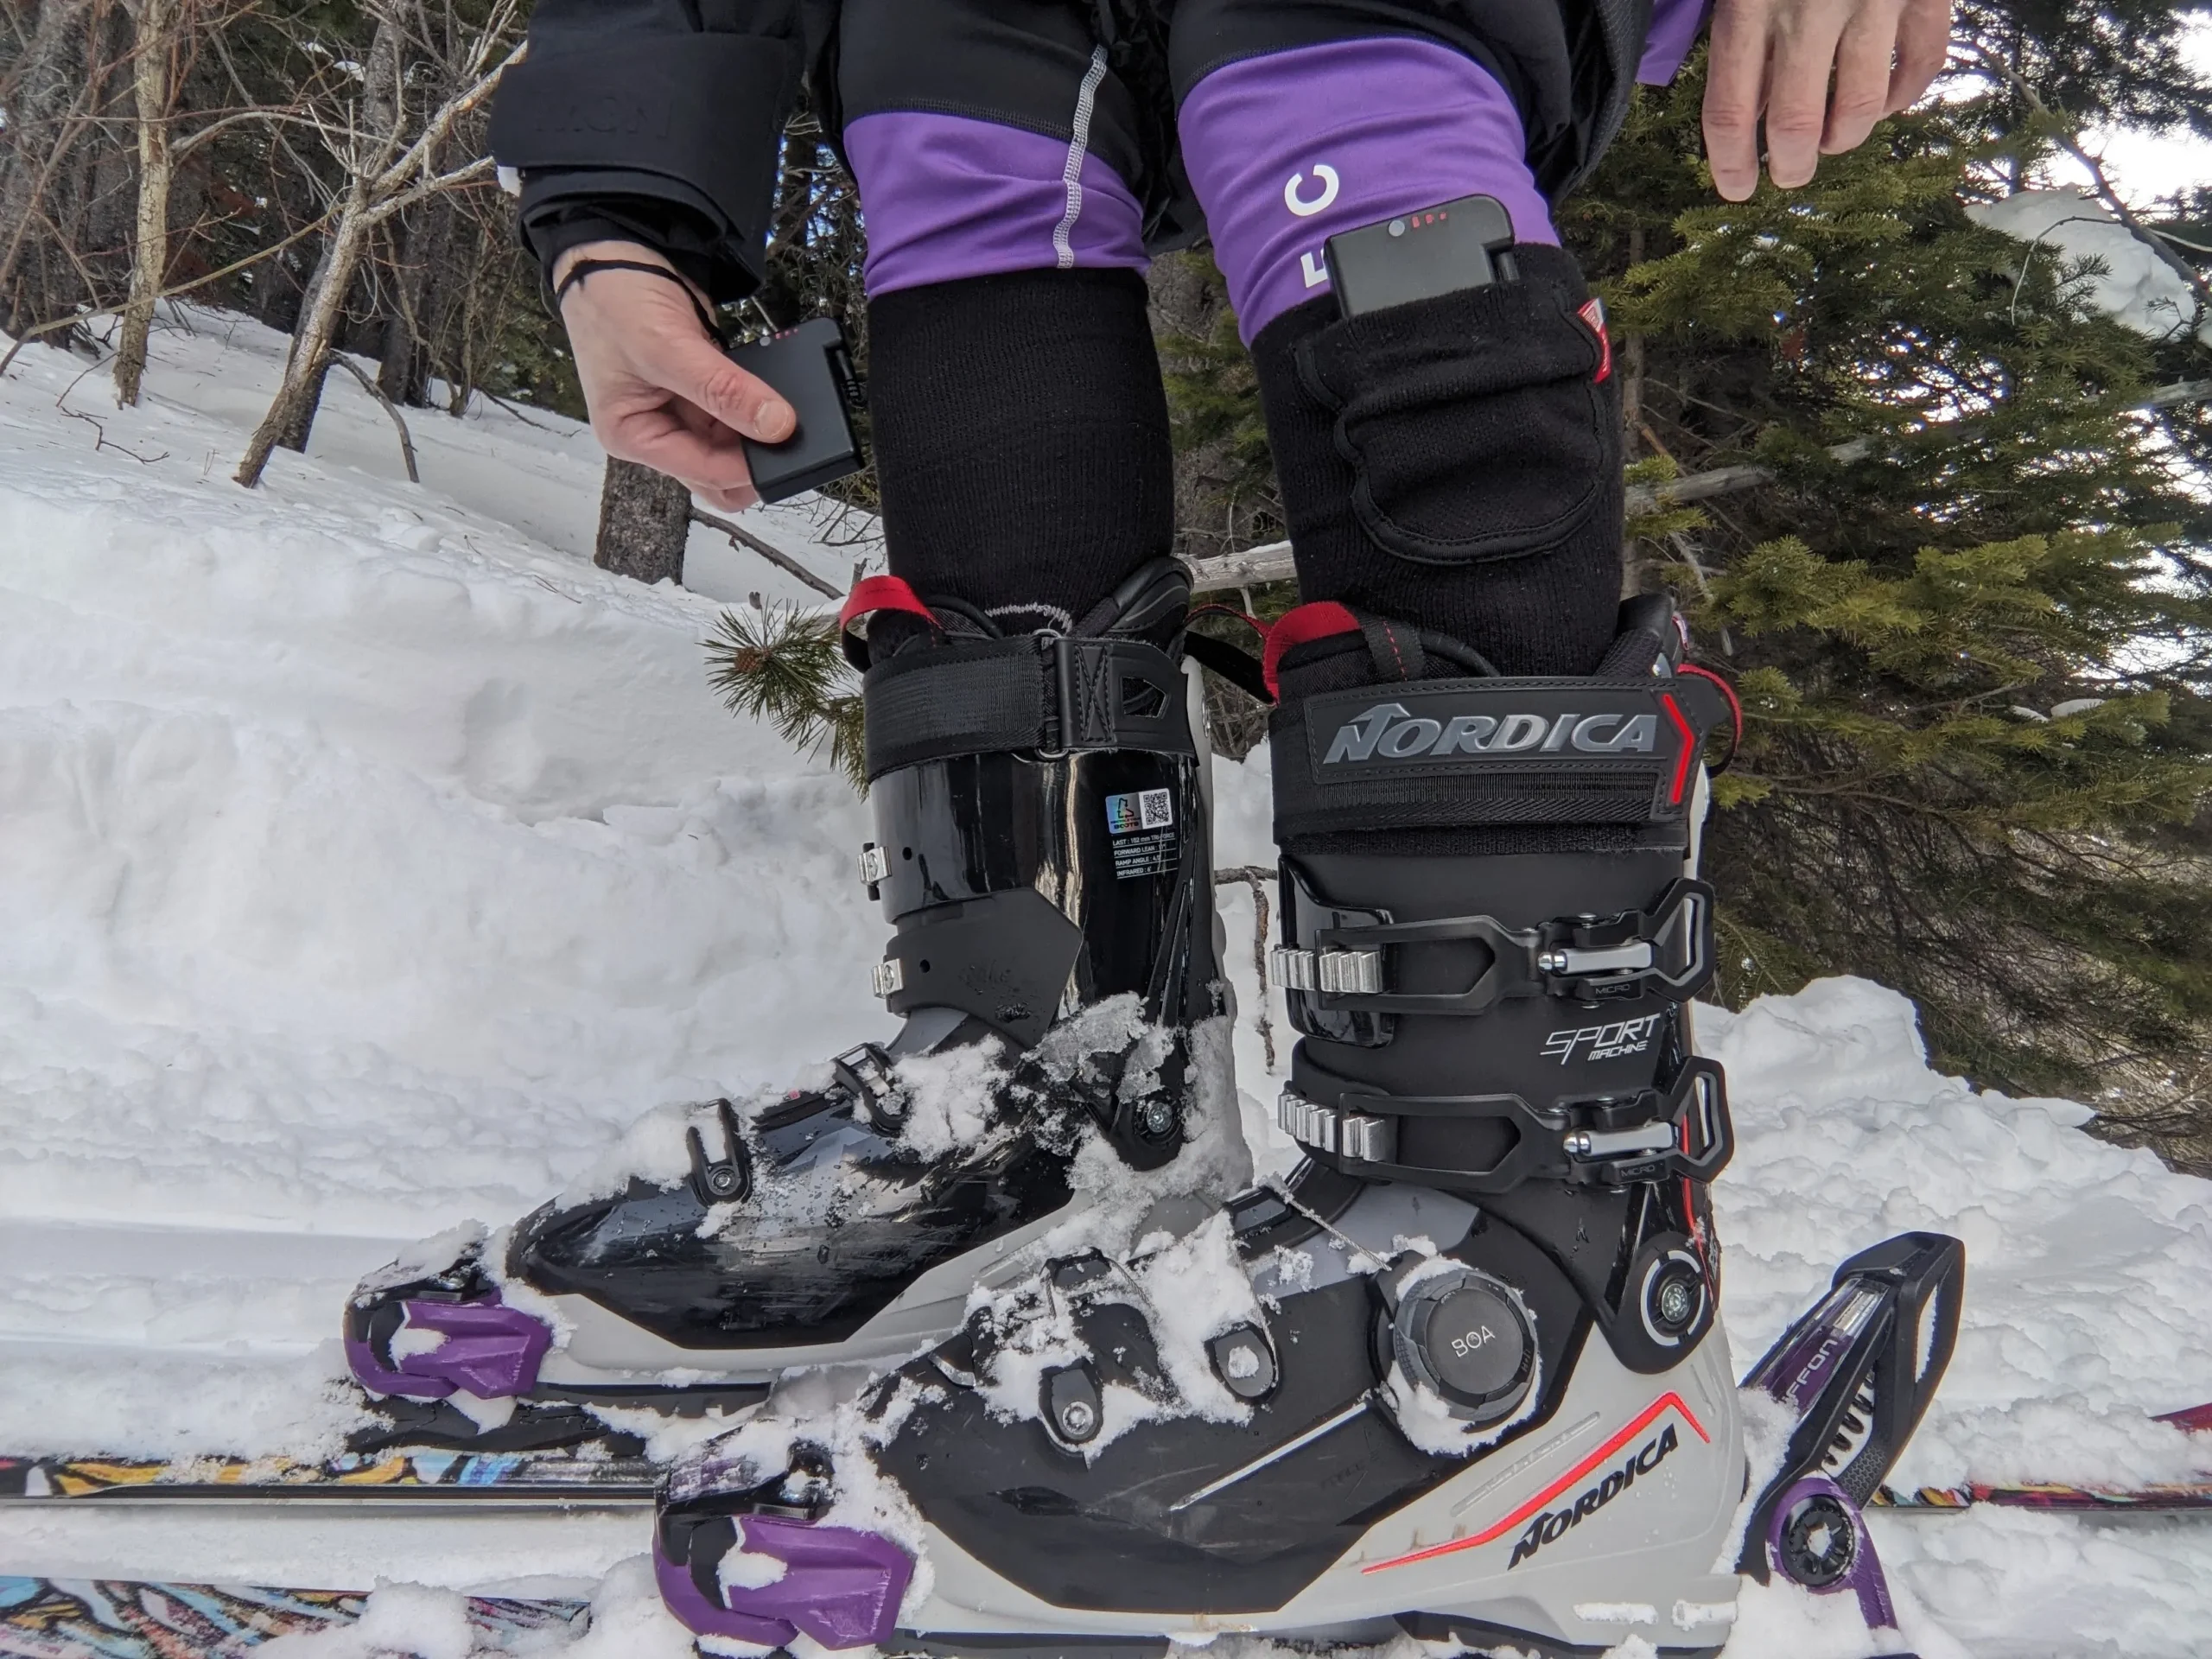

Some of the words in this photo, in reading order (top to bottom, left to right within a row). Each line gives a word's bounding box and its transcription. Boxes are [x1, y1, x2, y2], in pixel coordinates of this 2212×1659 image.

[1323, 702, 1657, 764] NORDICA
[1114, 821, 1139, 830] BOOTS
[1114, 847, 1141, 856] FORWARD
[1116, 868, 1143, 877] INFRARED
[1596, 983, 1630, 994] MICRO
[1540, 1013, 1661, 1065] SPORT
[1587, 1039, 1649, 1061] MACHINE
[1452, 1325, 1496, 1357] BOA
[1506, 1423, 1678, 1571] NORDICA
